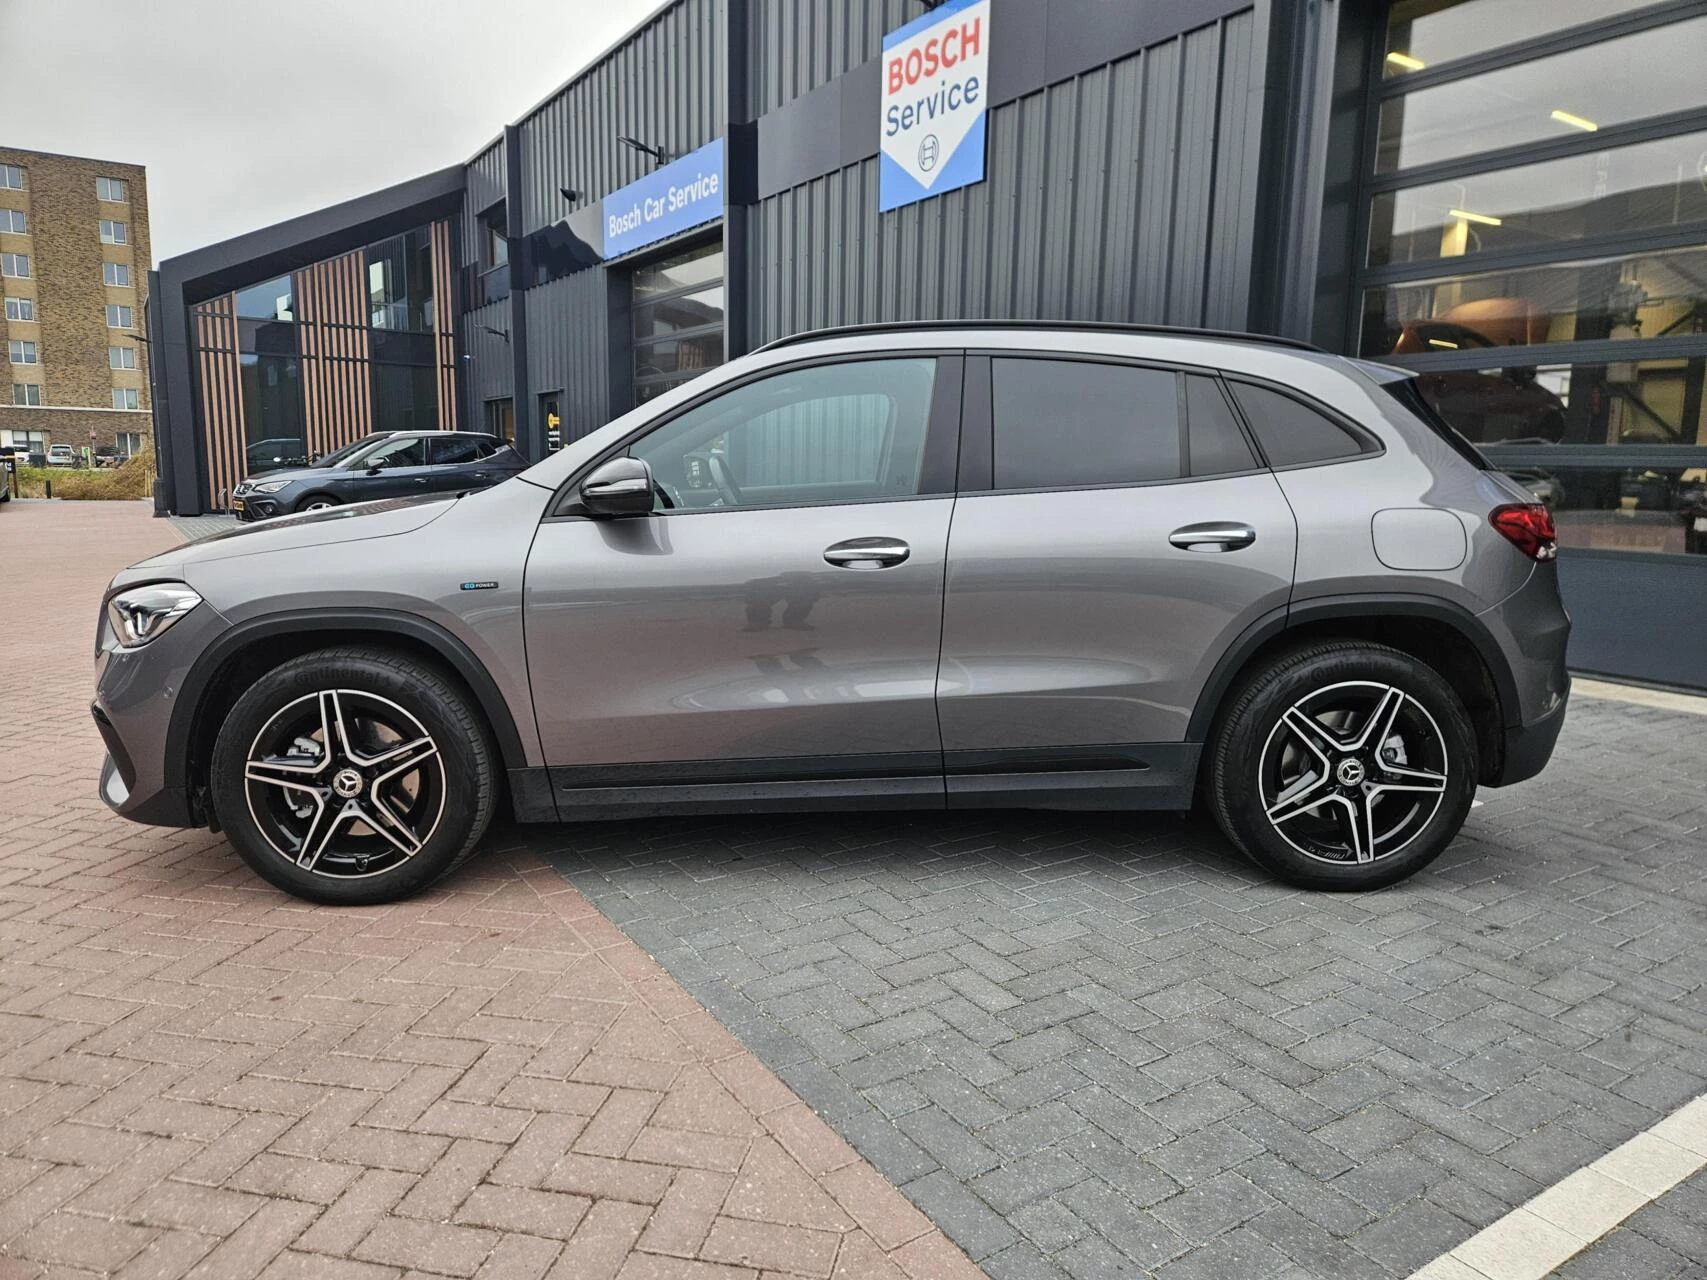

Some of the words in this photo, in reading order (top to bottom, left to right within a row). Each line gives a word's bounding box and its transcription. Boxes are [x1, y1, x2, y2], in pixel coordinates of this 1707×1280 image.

[888, 16, 980, 95] BOSCH
[886, 76, 979, 137] Service
[609, 203, 641, 238] Bosch
[644, 197, 666, 222] Car
[668, 173, 718, 212] Service
